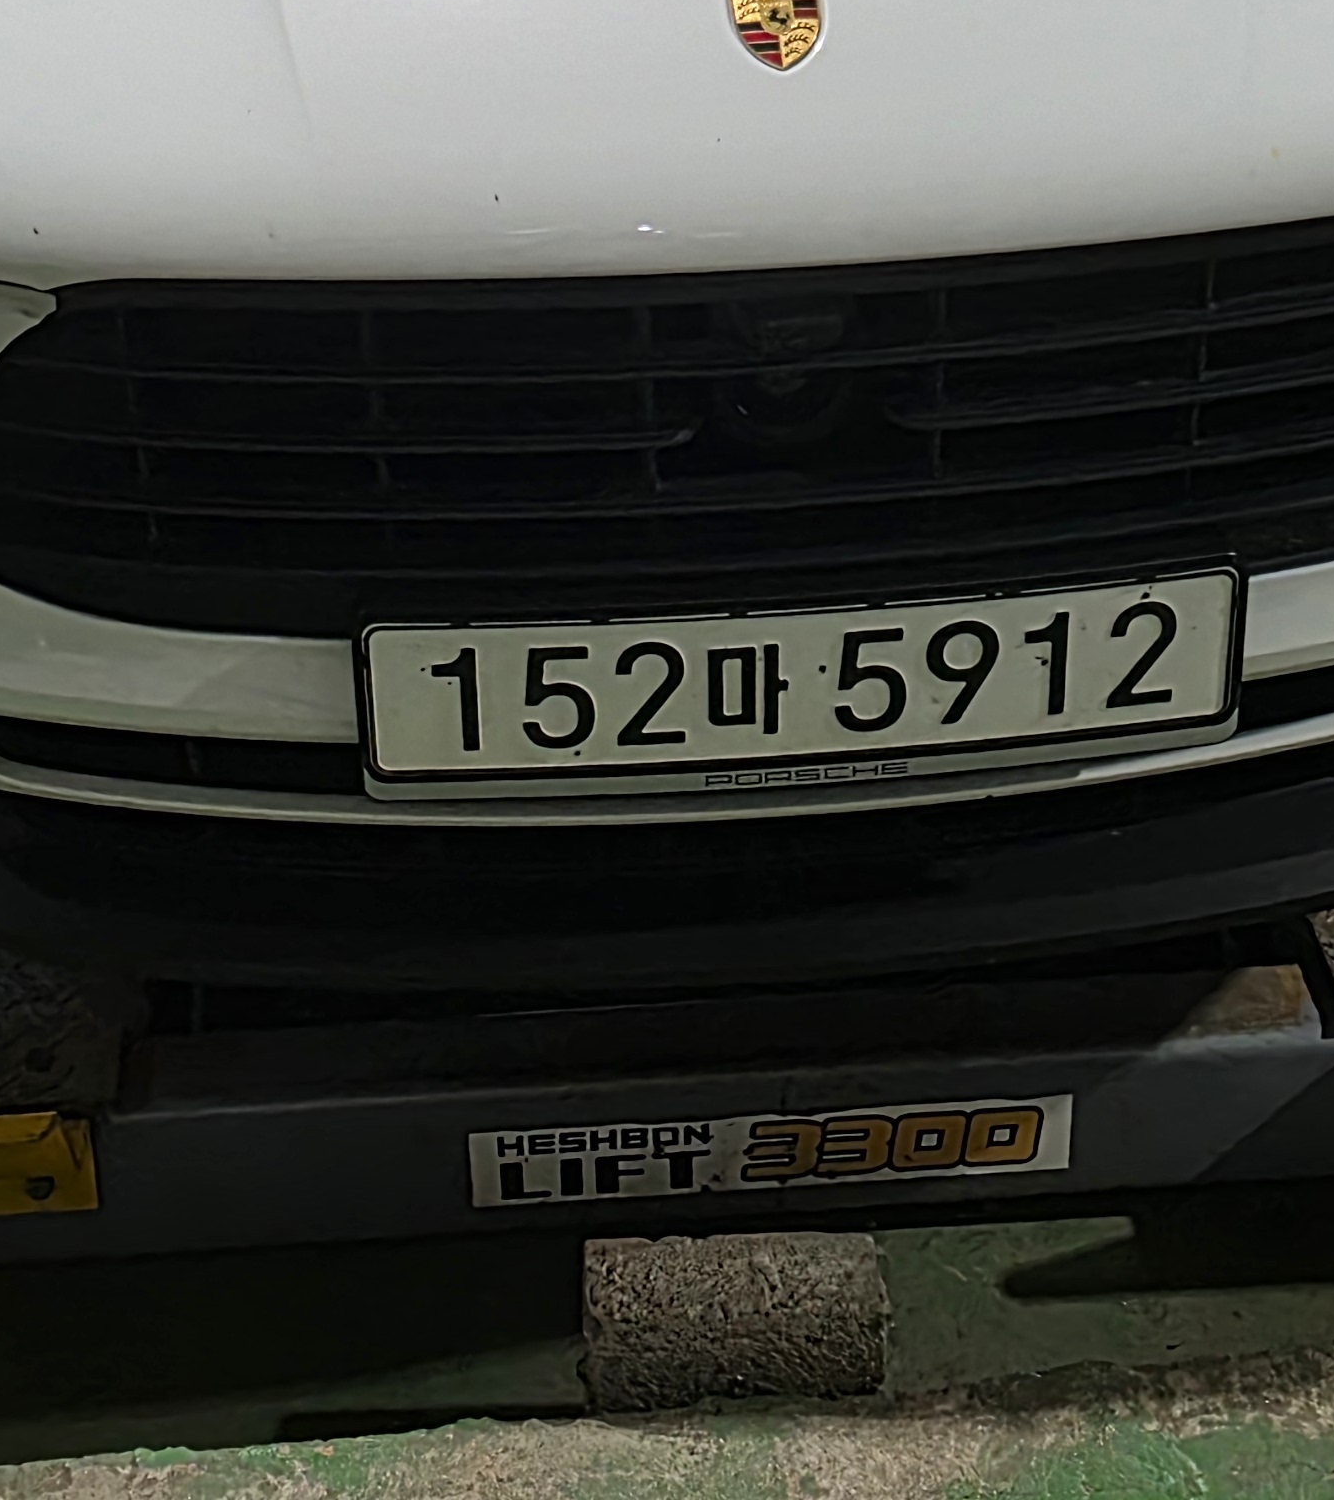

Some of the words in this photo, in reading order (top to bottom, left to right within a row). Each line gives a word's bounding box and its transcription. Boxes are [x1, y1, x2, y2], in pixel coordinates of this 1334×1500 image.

[431, 640, 790, 753] 152마
[834, 601, 1179, 734] 5912
[704, 761, 909, 788] PORSCHE
[496, 1123, 714, 1157] HESHBON
[499, 1149, 711, 1200] LIFT
[740, 1106, 1045, 1182] 3300
